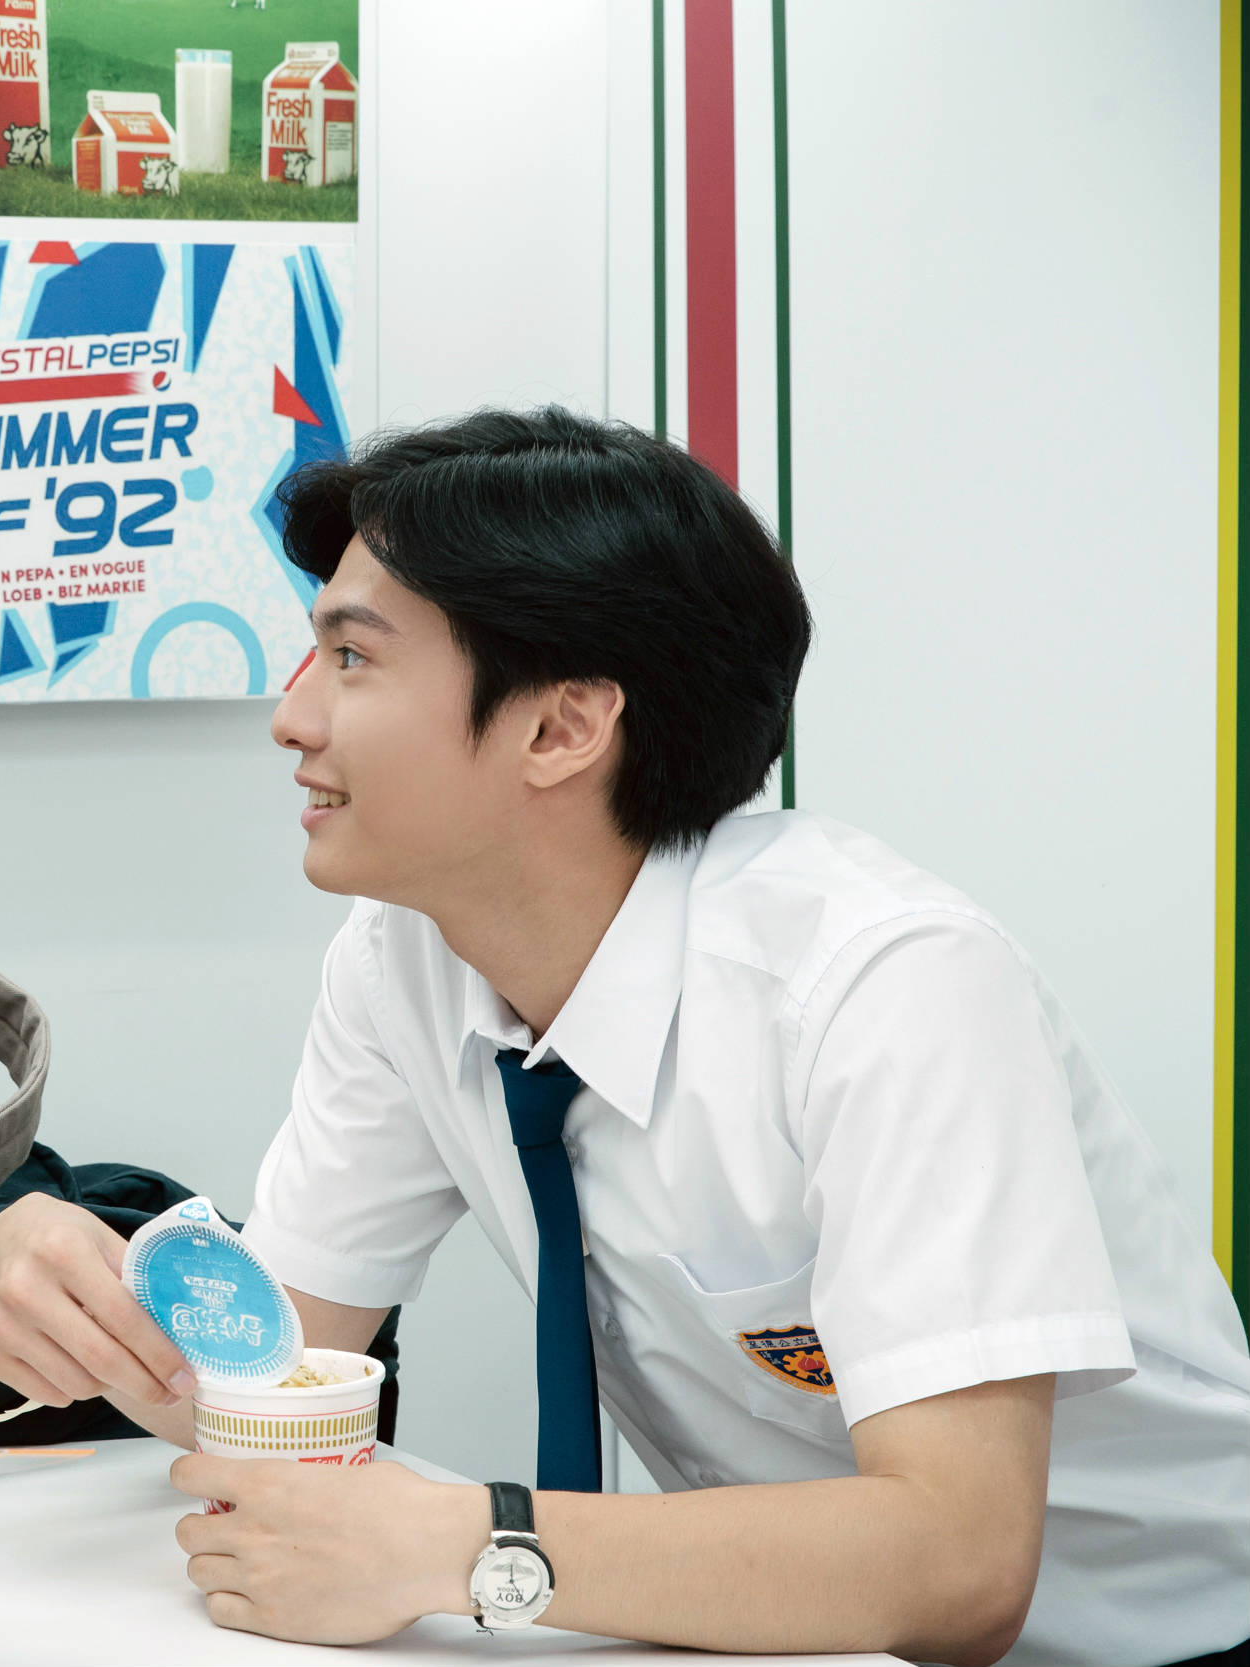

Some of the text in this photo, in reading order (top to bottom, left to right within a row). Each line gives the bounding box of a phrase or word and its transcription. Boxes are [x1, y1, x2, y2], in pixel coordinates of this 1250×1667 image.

[267, 91, 312, 118] Fresh
[271, 119, 307, 146] Milk
[44, 477, 177, 557] '92
[1, 570, 11, 583] N
[16, 567, 55, 582] PEPA
[70, 564, 89, 578] EN
[92, 560, 146, 576] VOGUE
[3, 588, 43, 603] LOEB
[58, 584, 83, 599] BIZ
[87, 579, 146, 596] MARKIE
[496, 1593, 523, 1604] BOY
